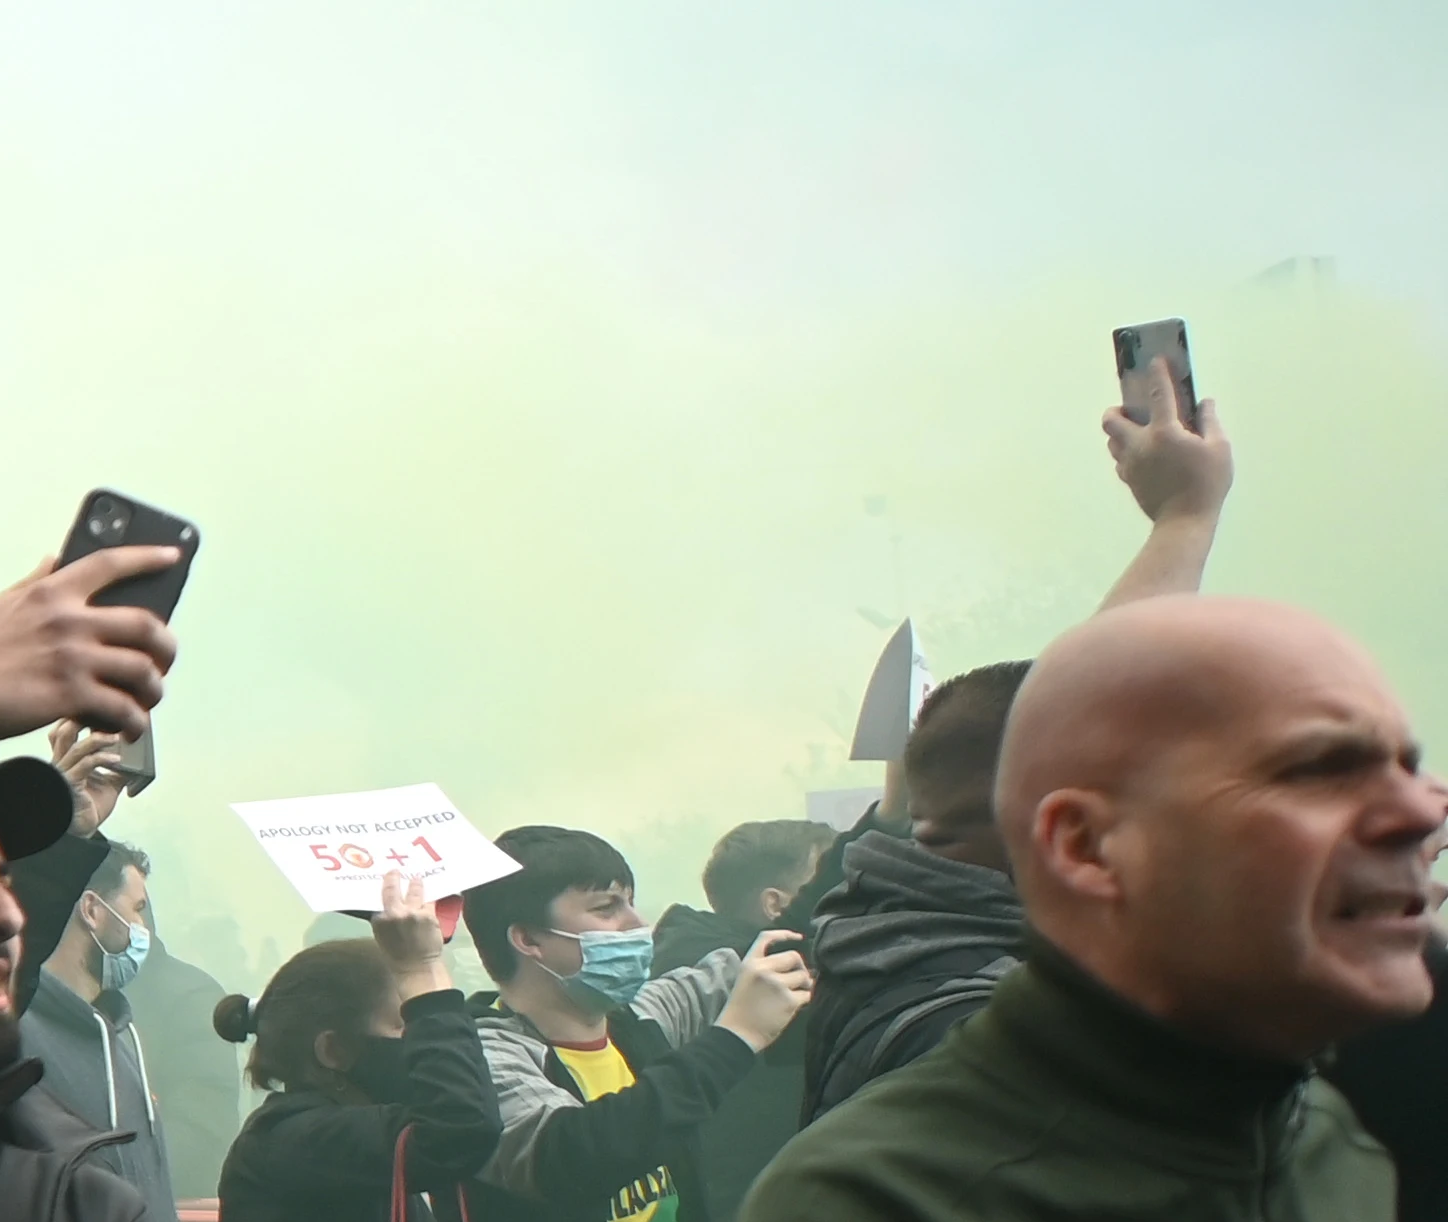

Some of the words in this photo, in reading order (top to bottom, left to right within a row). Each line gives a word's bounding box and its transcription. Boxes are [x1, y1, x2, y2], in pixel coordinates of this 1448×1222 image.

[259, 824, 331, 838] APOLOGY
[335, 823, 368, 835] NOT
[374, 811, 456, 833] ACCEPTED
